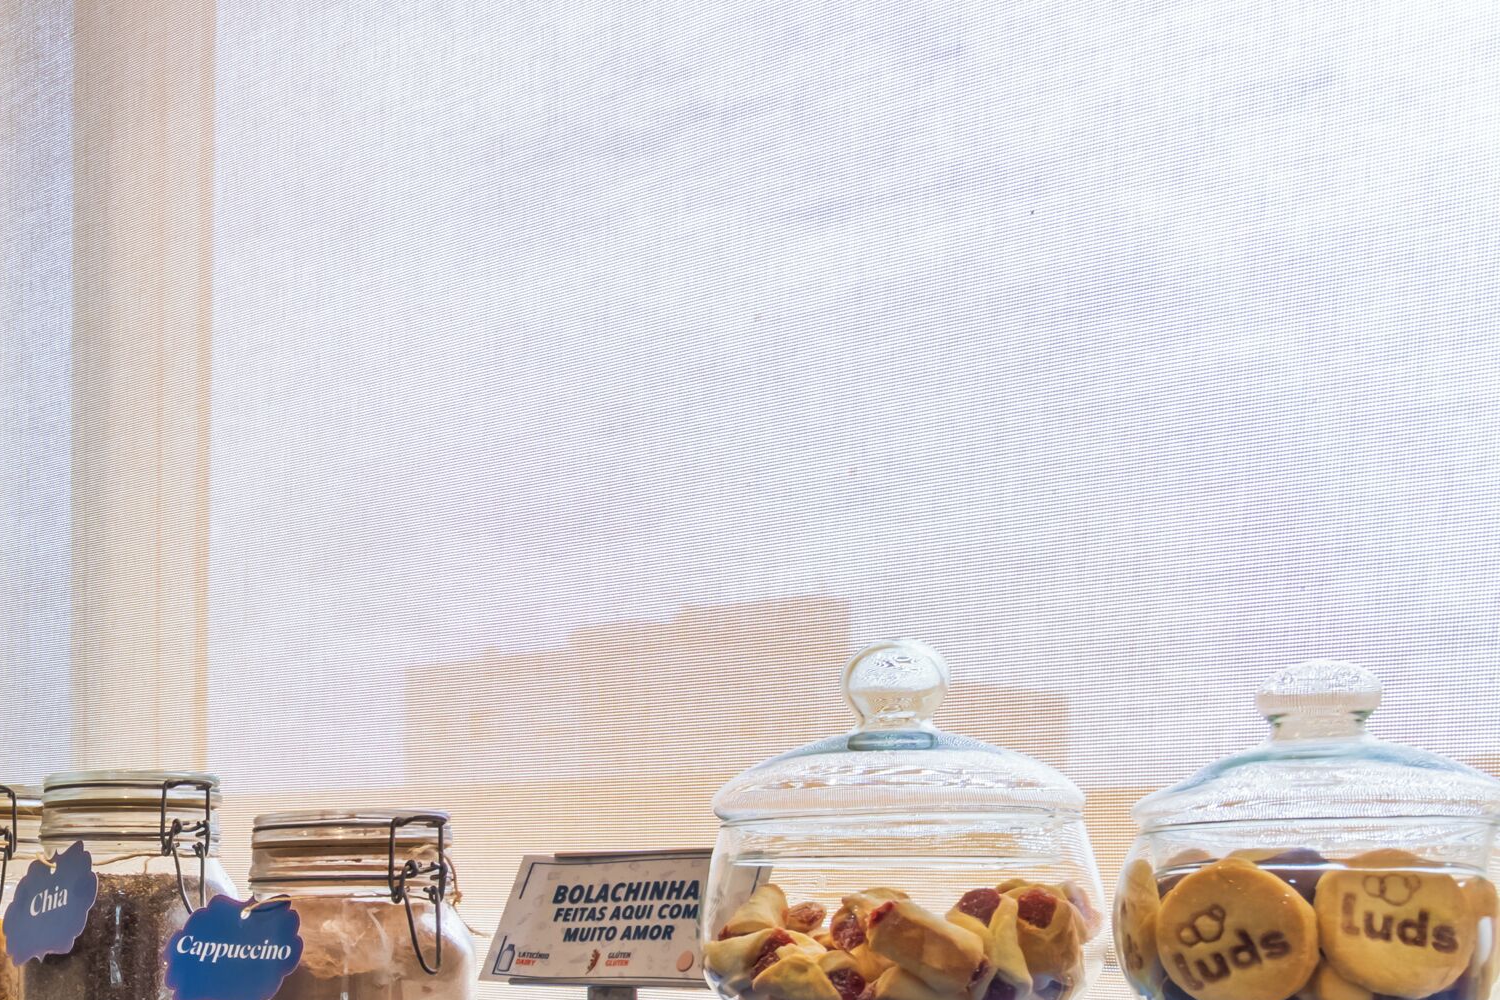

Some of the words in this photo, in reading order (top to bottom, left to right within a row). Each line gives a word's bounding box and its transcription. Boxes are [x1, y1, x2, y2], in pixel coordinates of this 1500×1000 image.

[29, 886, 68, 917] Chia
[552, 880, 700, 904] BOLACHINHA
[553, 906, 608, 922] FEITAS
[609, 904, 654, 921] AQUI
[657, 903, 700, 919] COM
[1341, 892, 1460, 954] luds
[563, 925, 618, 943] MUITO
[620, 924, 675, 941] AMOR
[176, 935, 292, 963] Cappuccino
[1173, 928, 1292, 992] luds
